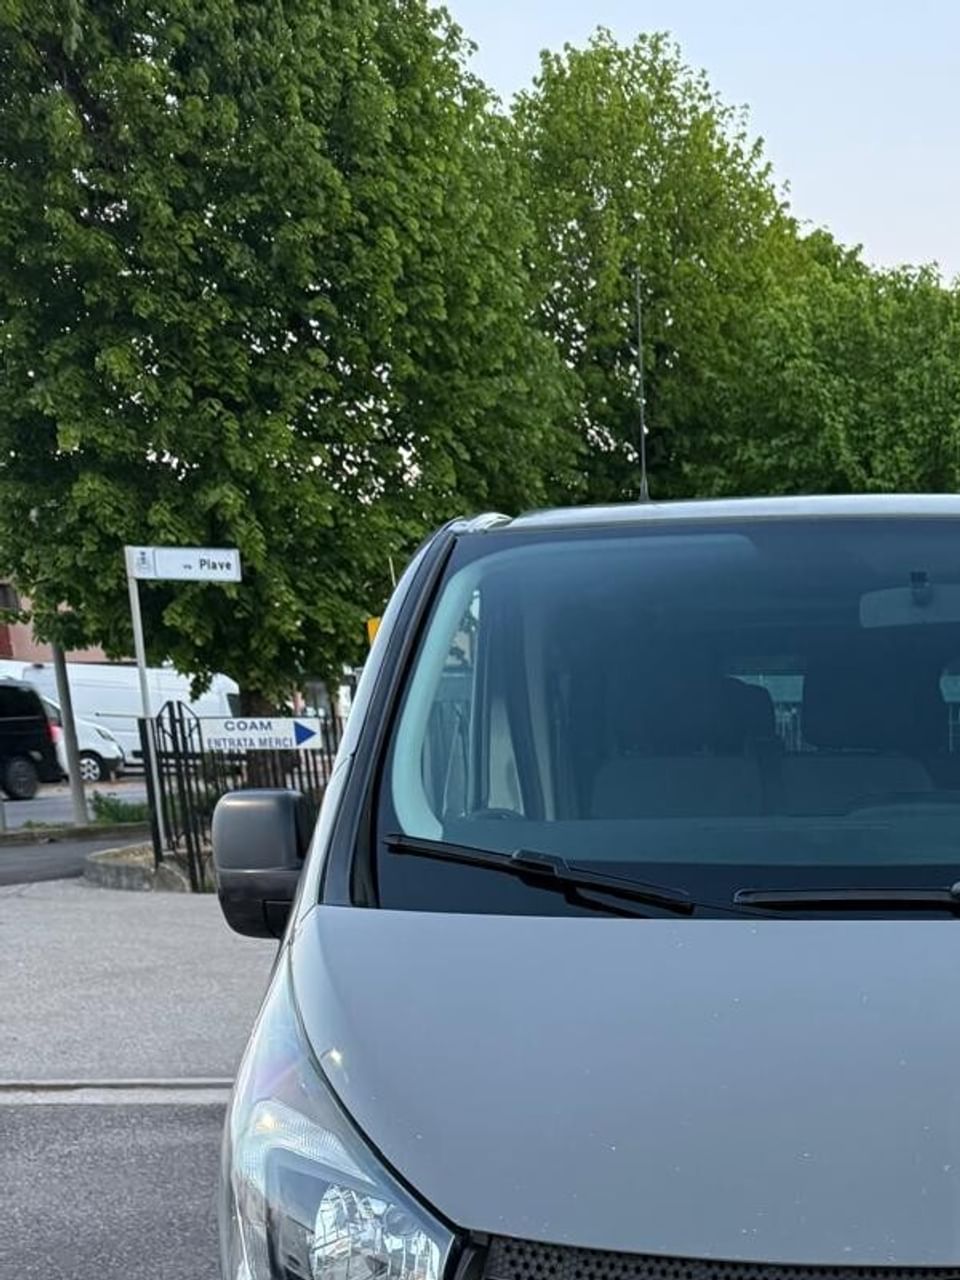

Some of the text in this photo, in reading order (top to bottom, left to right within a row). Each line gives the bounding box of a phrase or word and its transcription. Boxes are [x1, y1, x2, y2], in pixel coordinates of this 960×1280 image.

[199, 558, 232, 570] Piave
[223, 720, 273, 731] COAM
[207, 737, 293, 748] ENTRATA MERCI
